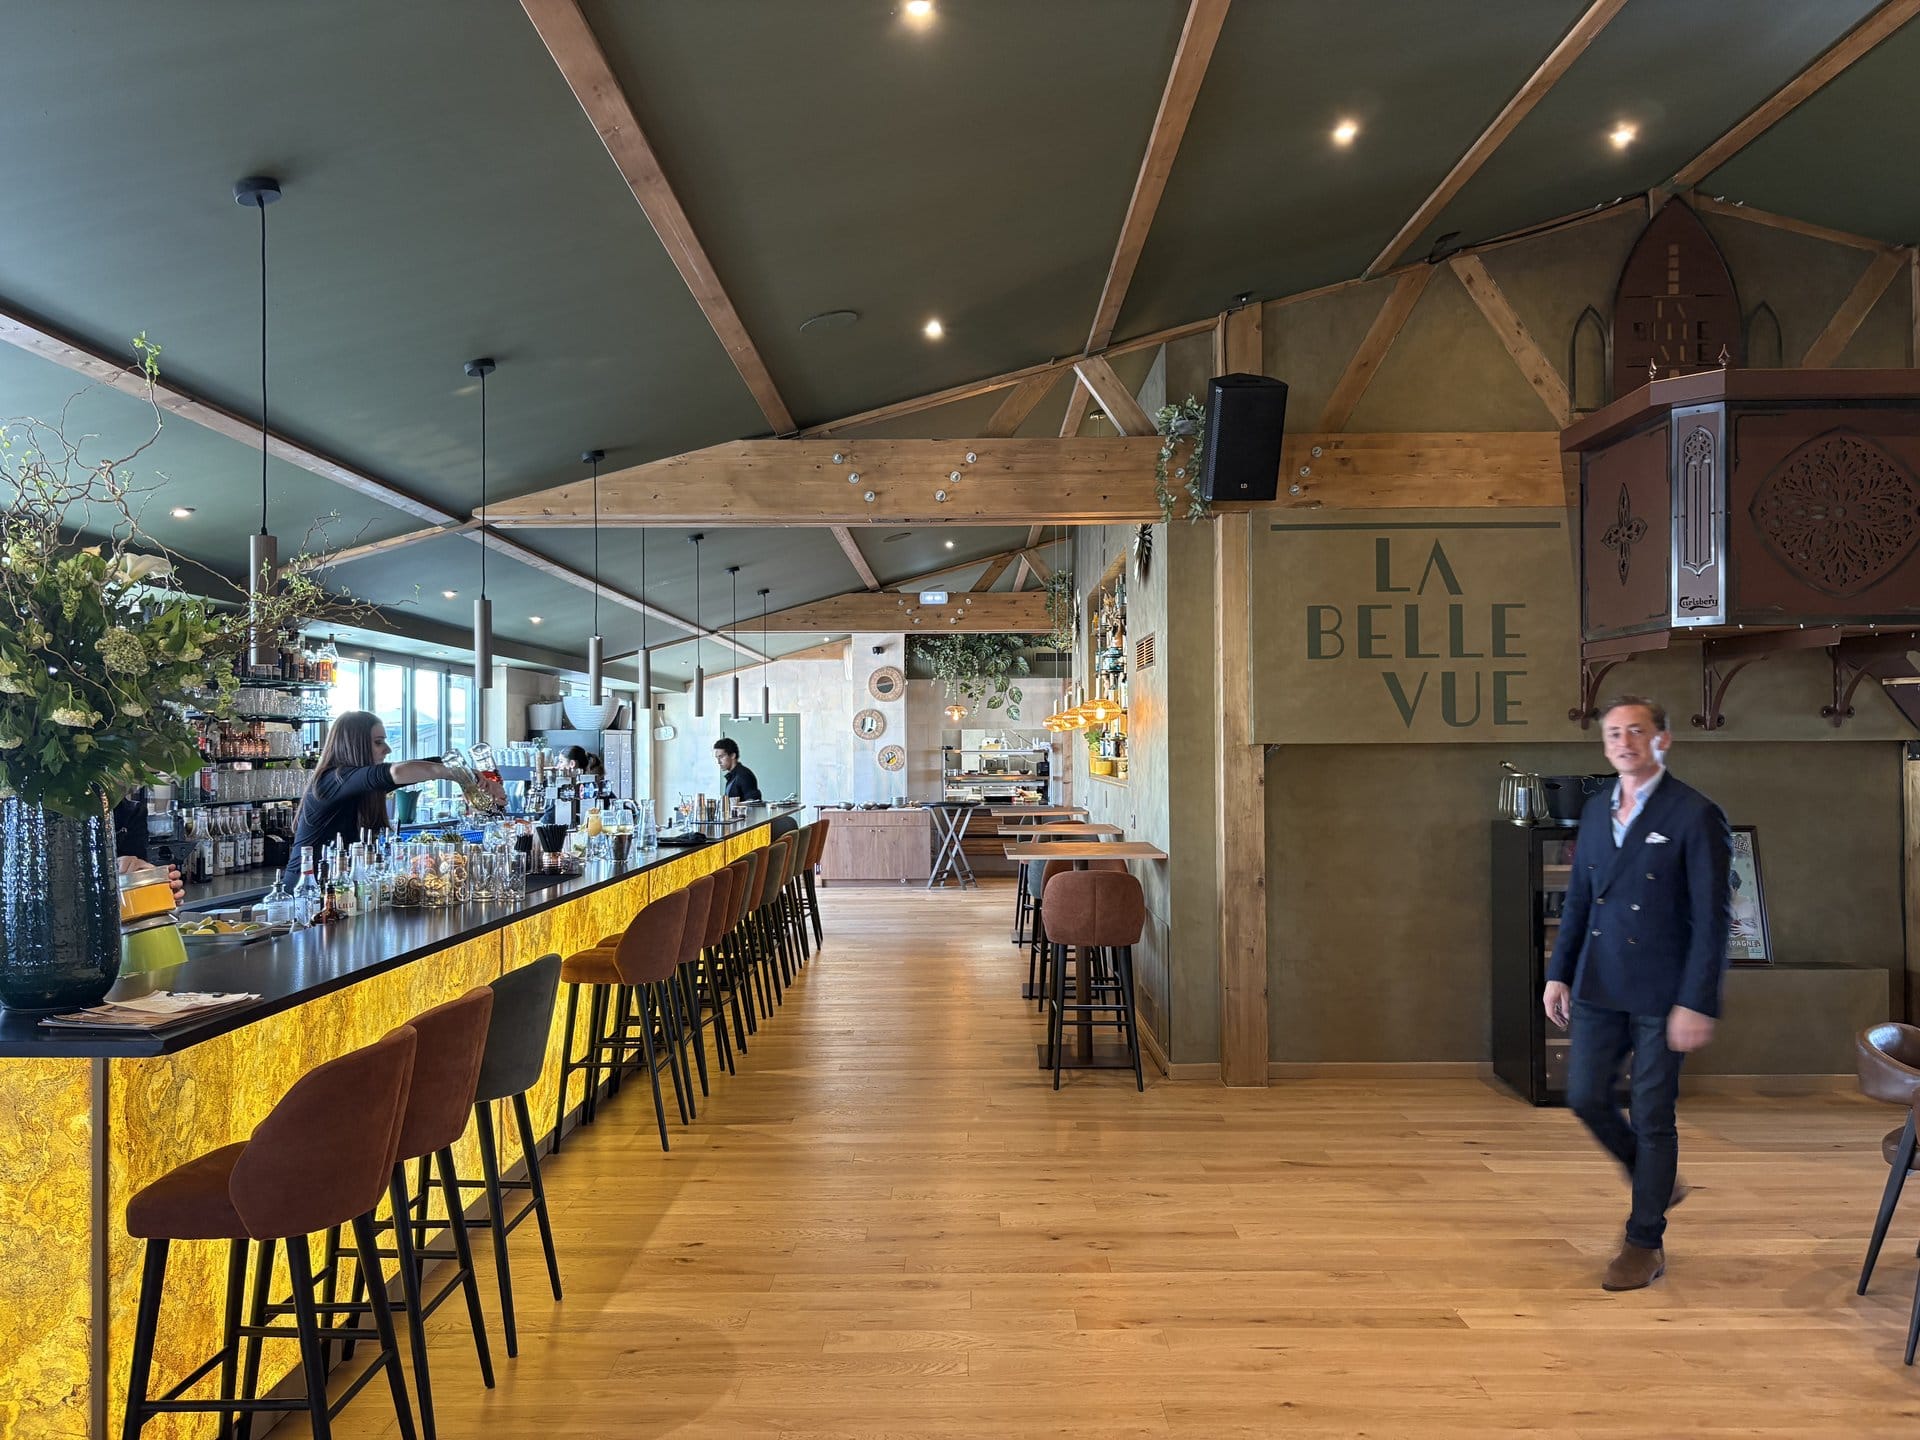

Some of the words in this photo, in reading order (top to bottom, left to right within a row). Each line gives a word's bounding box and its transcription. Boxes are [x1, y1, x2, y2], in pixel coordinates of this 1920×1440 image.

[1375, 537, 1464, 596] LA
[1306, 603, 1527, 660] BELLE
[1679, 596, 1718, 611] Carlsberg
[1381, 670, 1529, 729] VUE
